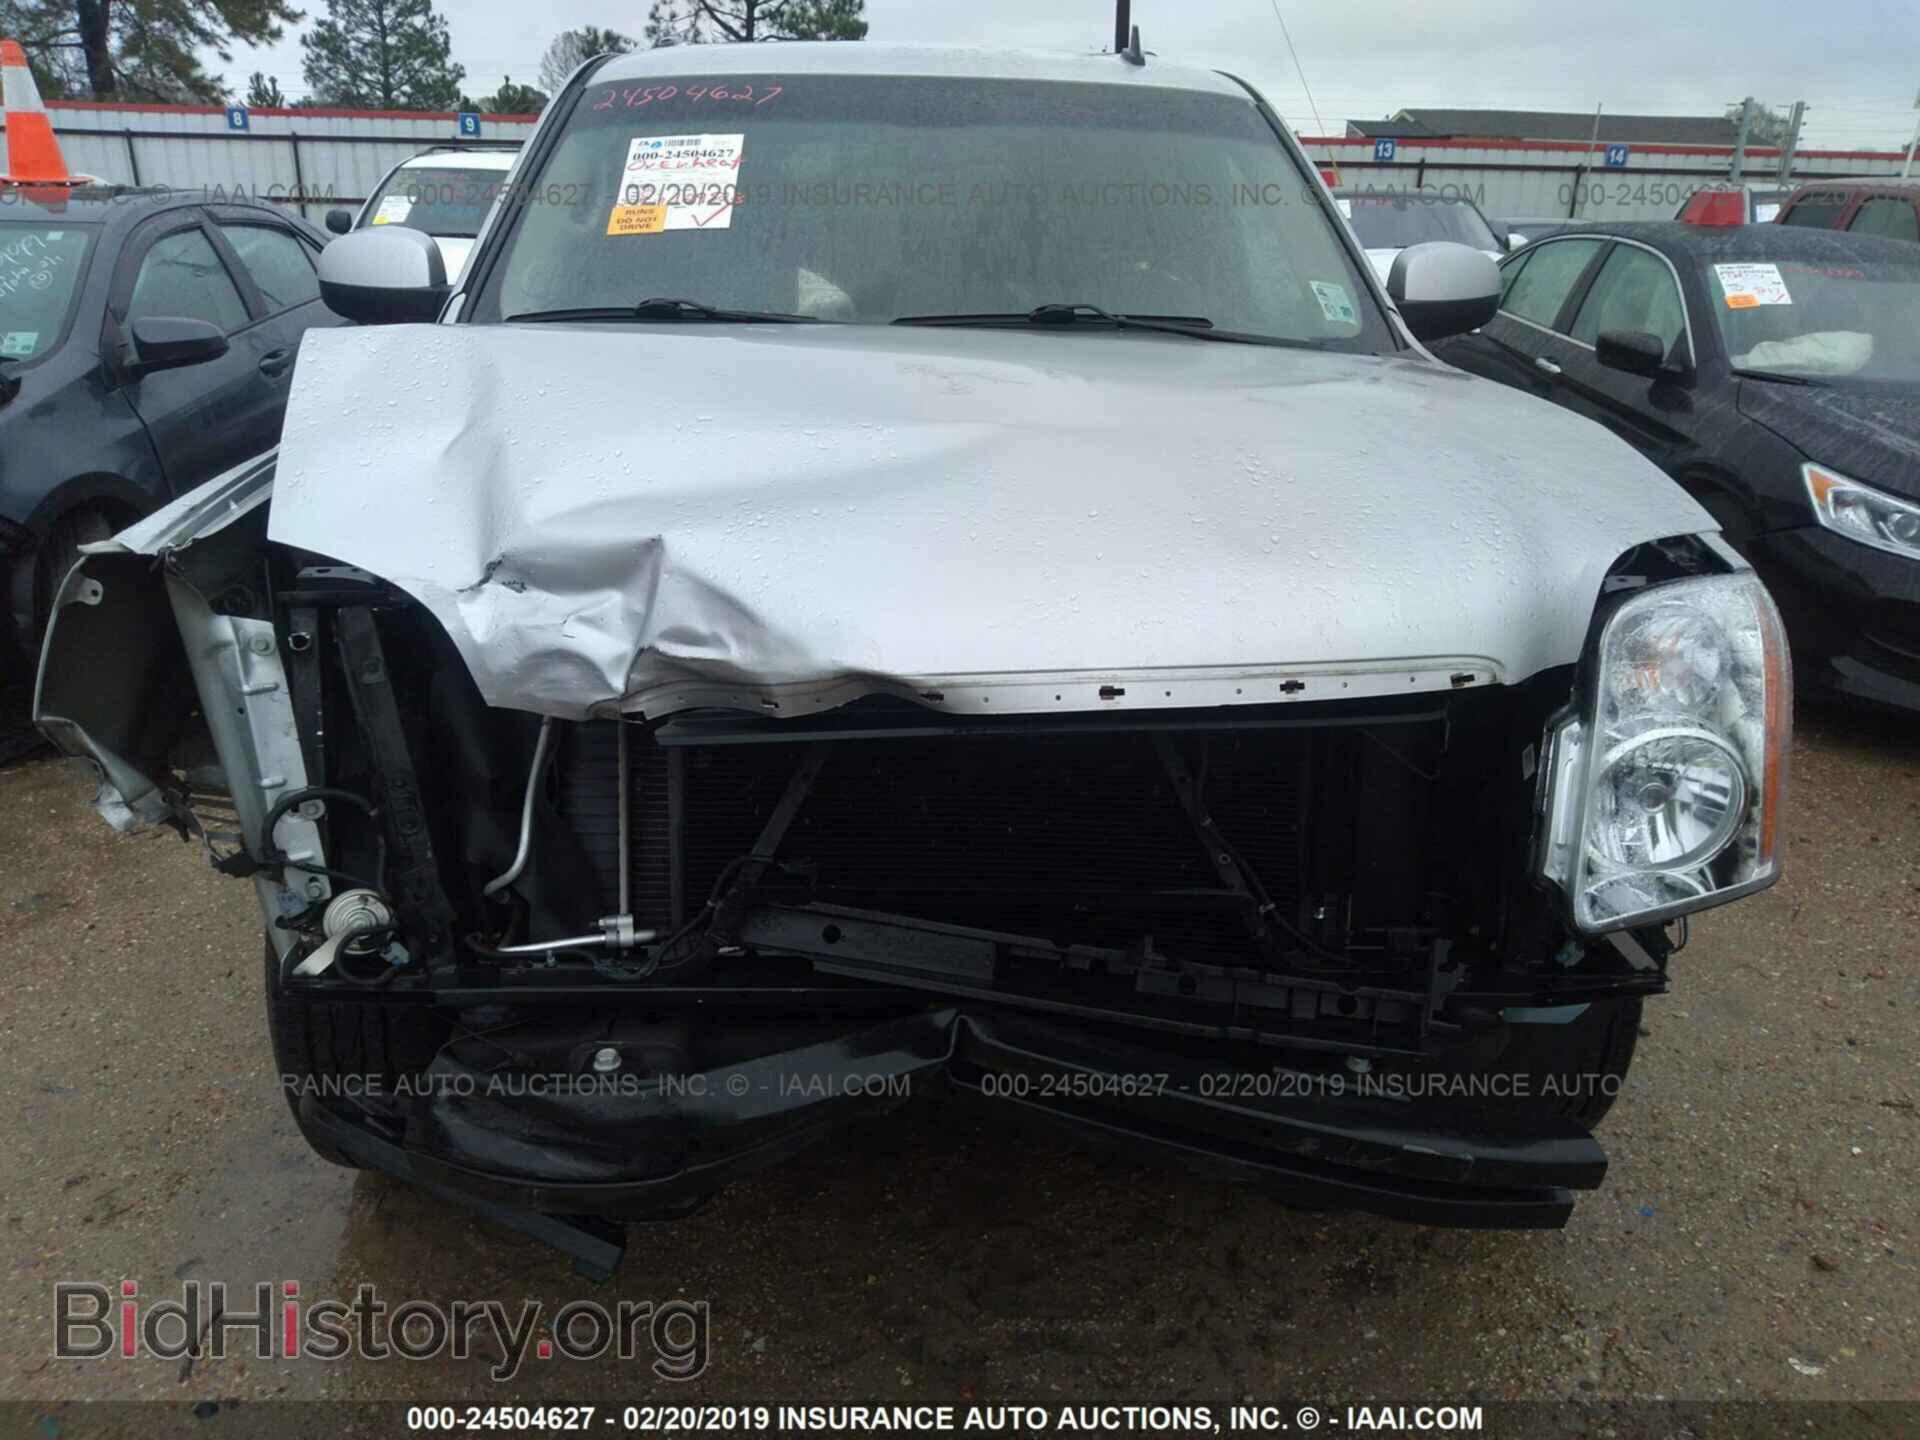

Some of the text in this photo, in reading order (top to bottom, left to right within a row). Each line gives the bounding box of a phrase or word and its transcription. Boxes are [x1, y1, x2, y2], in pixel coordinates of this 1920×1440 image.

[232, 111, 243, 126] 8
[464, 117, 476, 133] 9
[632, 149, 735, 161] 000-24504627
[1376, 142, 1394, 159] 13
[1608, 148, 1625, 166] 14
